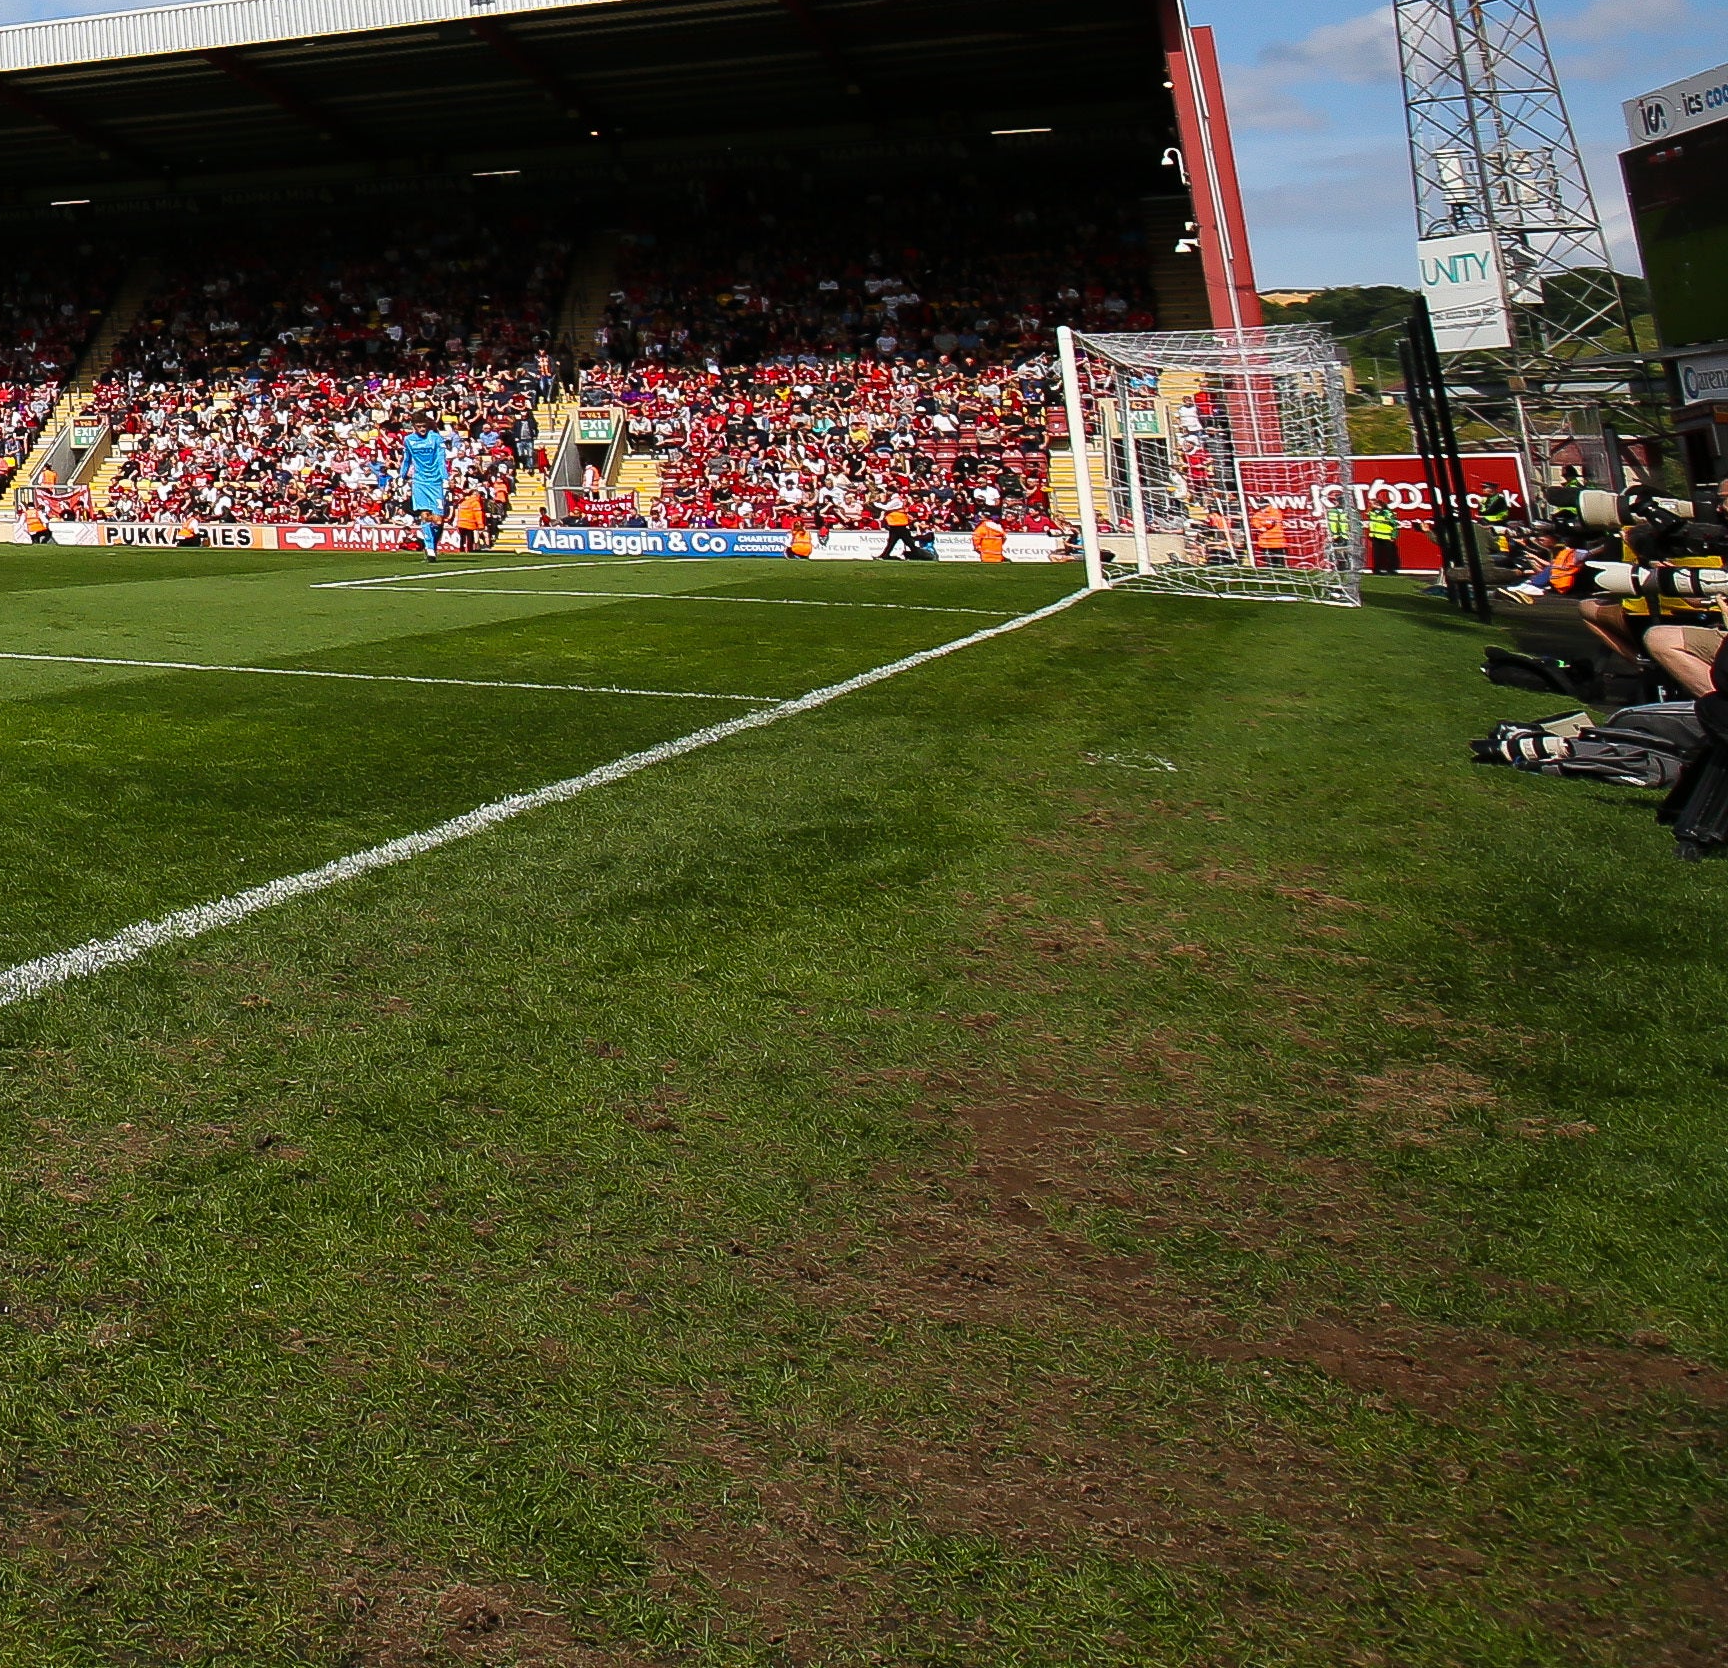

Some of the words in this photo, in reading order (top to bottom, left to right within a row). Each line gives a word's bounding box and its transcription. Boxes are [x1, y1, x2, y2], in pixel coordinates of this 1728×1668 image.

[74, 426, 100, 437] EXIT
[579, 419, 611, 431] EXIT
[106, 527, 181, 546] PUKKA
[532, 529, 585, 551] Alan
[587, 530, 662, 555] Biggin
[667, 532, 688, 553] &
[690, 533, 727, 554] Co
